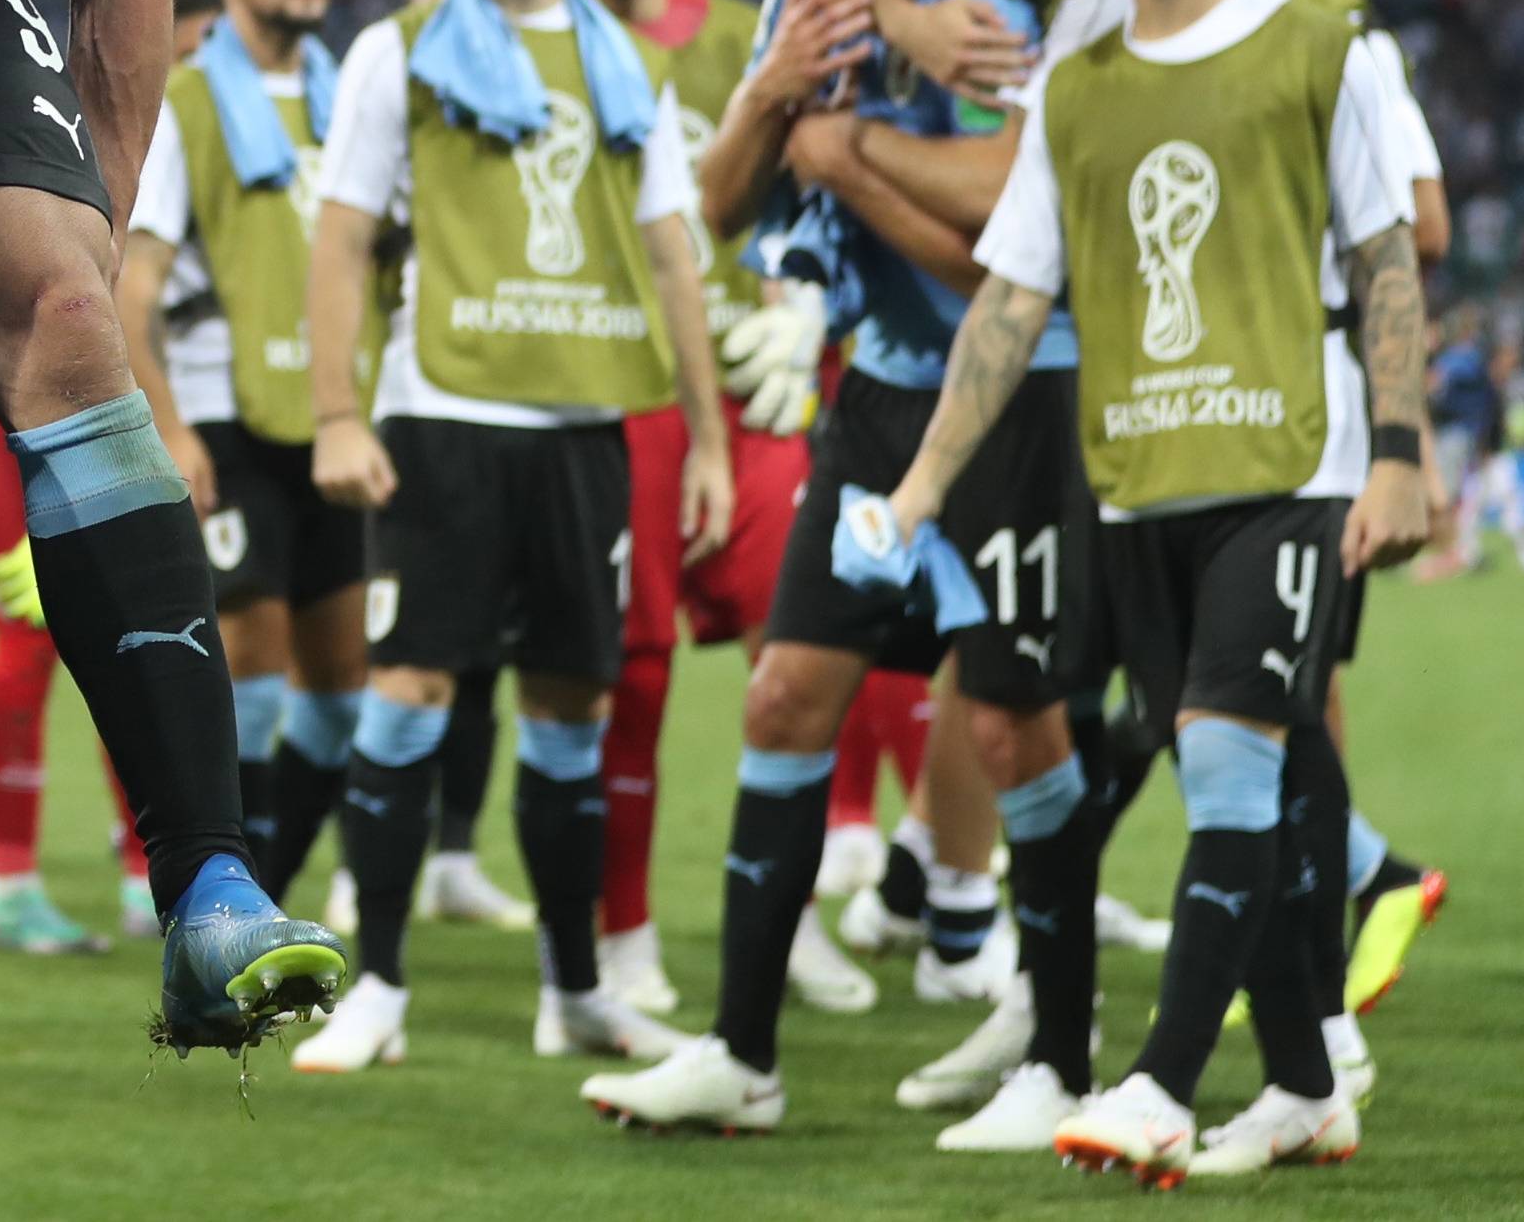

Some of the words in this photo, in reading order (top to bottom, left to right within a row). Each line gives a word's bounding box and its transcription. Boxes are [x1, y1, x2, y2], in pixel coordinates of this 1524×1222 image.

[1192, 387, 1284, 427] 2018
[976, 527, 1058, 624] 11
[1277, 541, 1318, 642] 4
